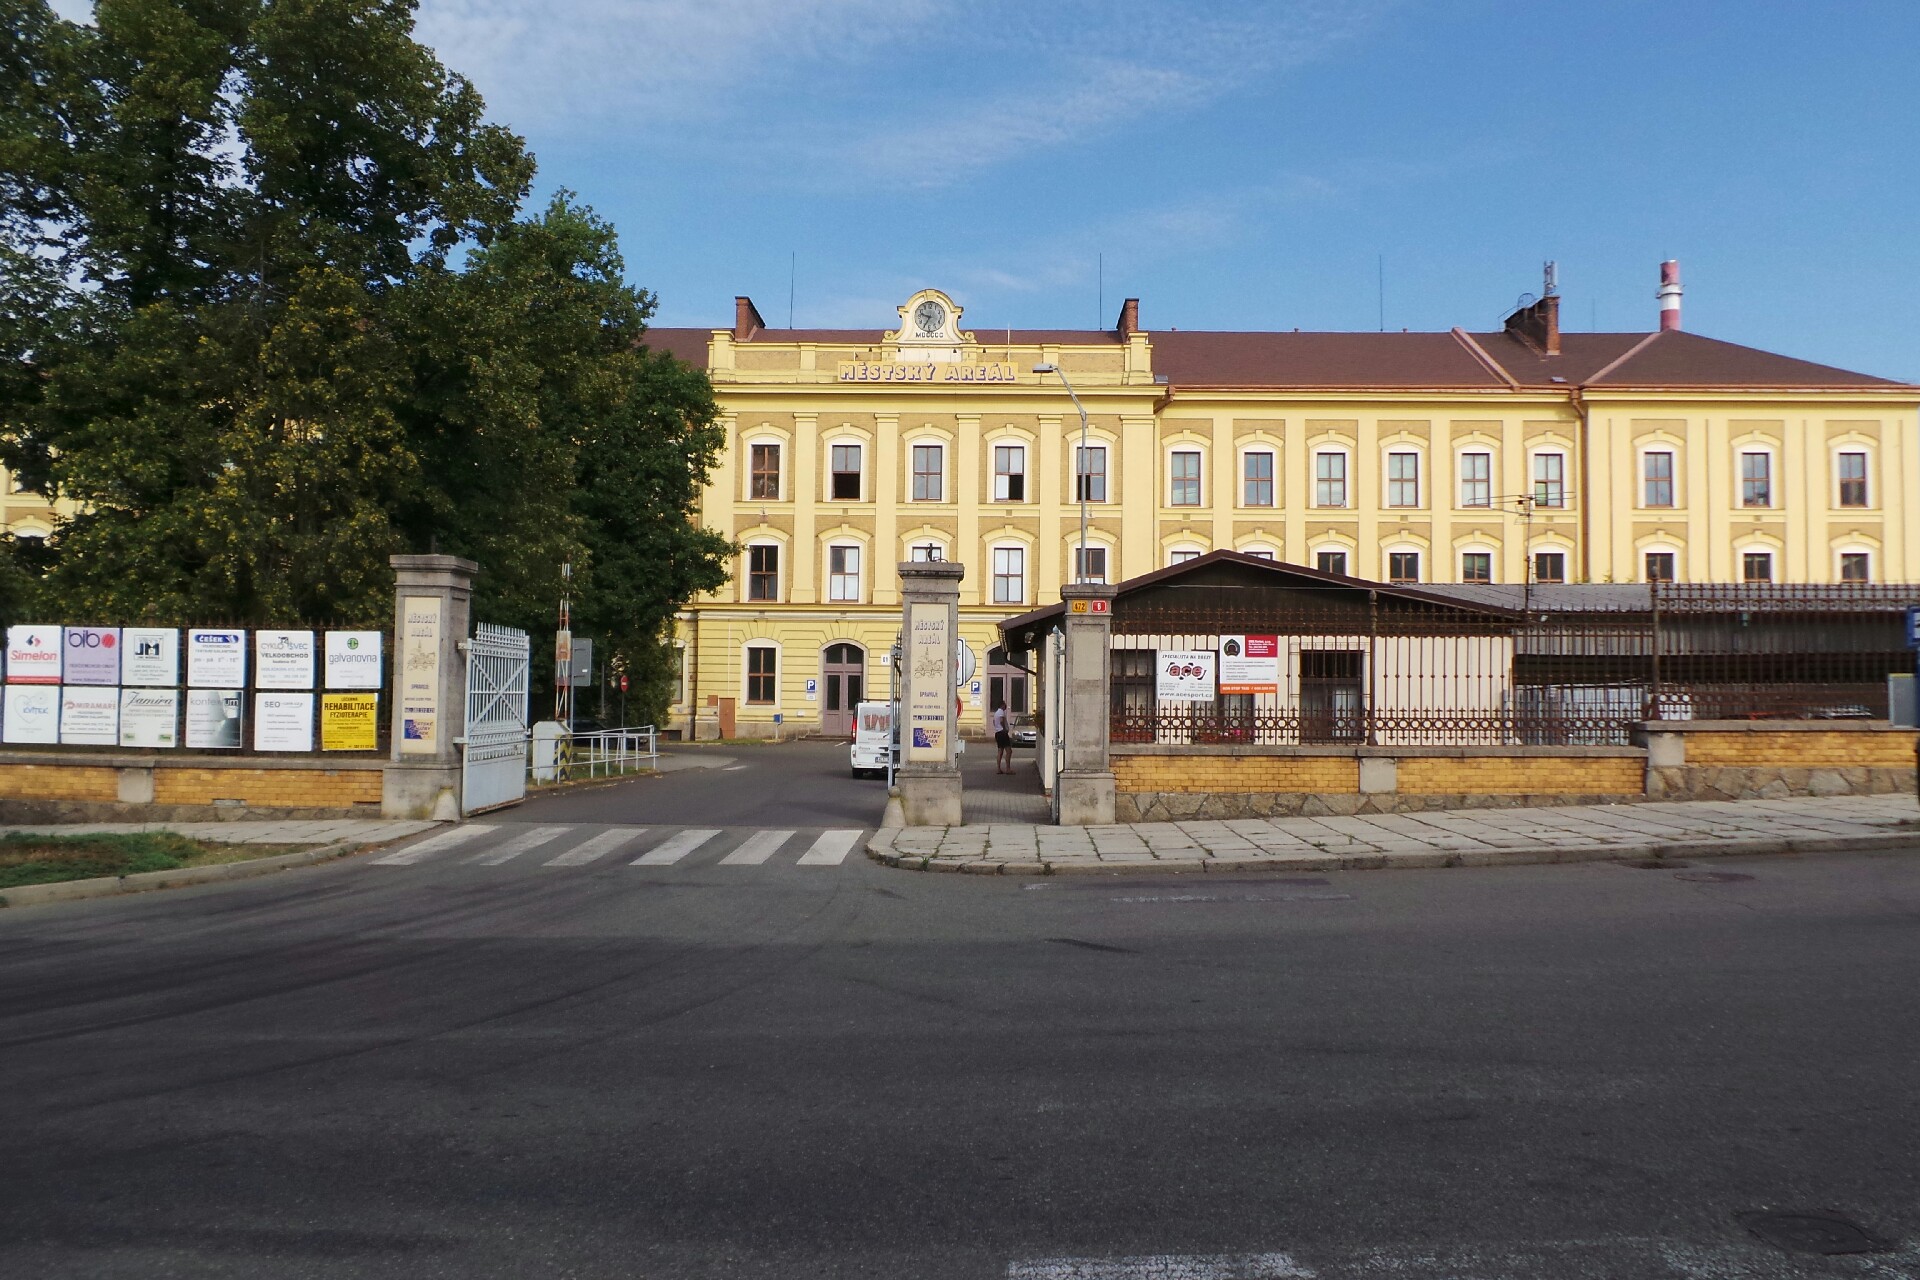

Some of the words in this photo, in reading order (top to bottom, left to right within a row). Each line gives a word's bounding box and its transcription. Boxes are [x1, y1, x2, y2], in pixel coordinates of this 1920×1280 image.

[840, 362, 936, 381] MĚSTSKÝ
[944, 363, 1015, 381] AREÁL
[1075, 602, 1085, 610] 472
[915, 620, 945, 631] MĚSTSKÝ
[261, 642, 284, 650] CYKLO
[11, 650, 57, 661] Simelon
[328, 653, 377, 665] galvanovna
[807, 681, 814, 690] P
[324, 702, 375, 710] REHABILITACE
